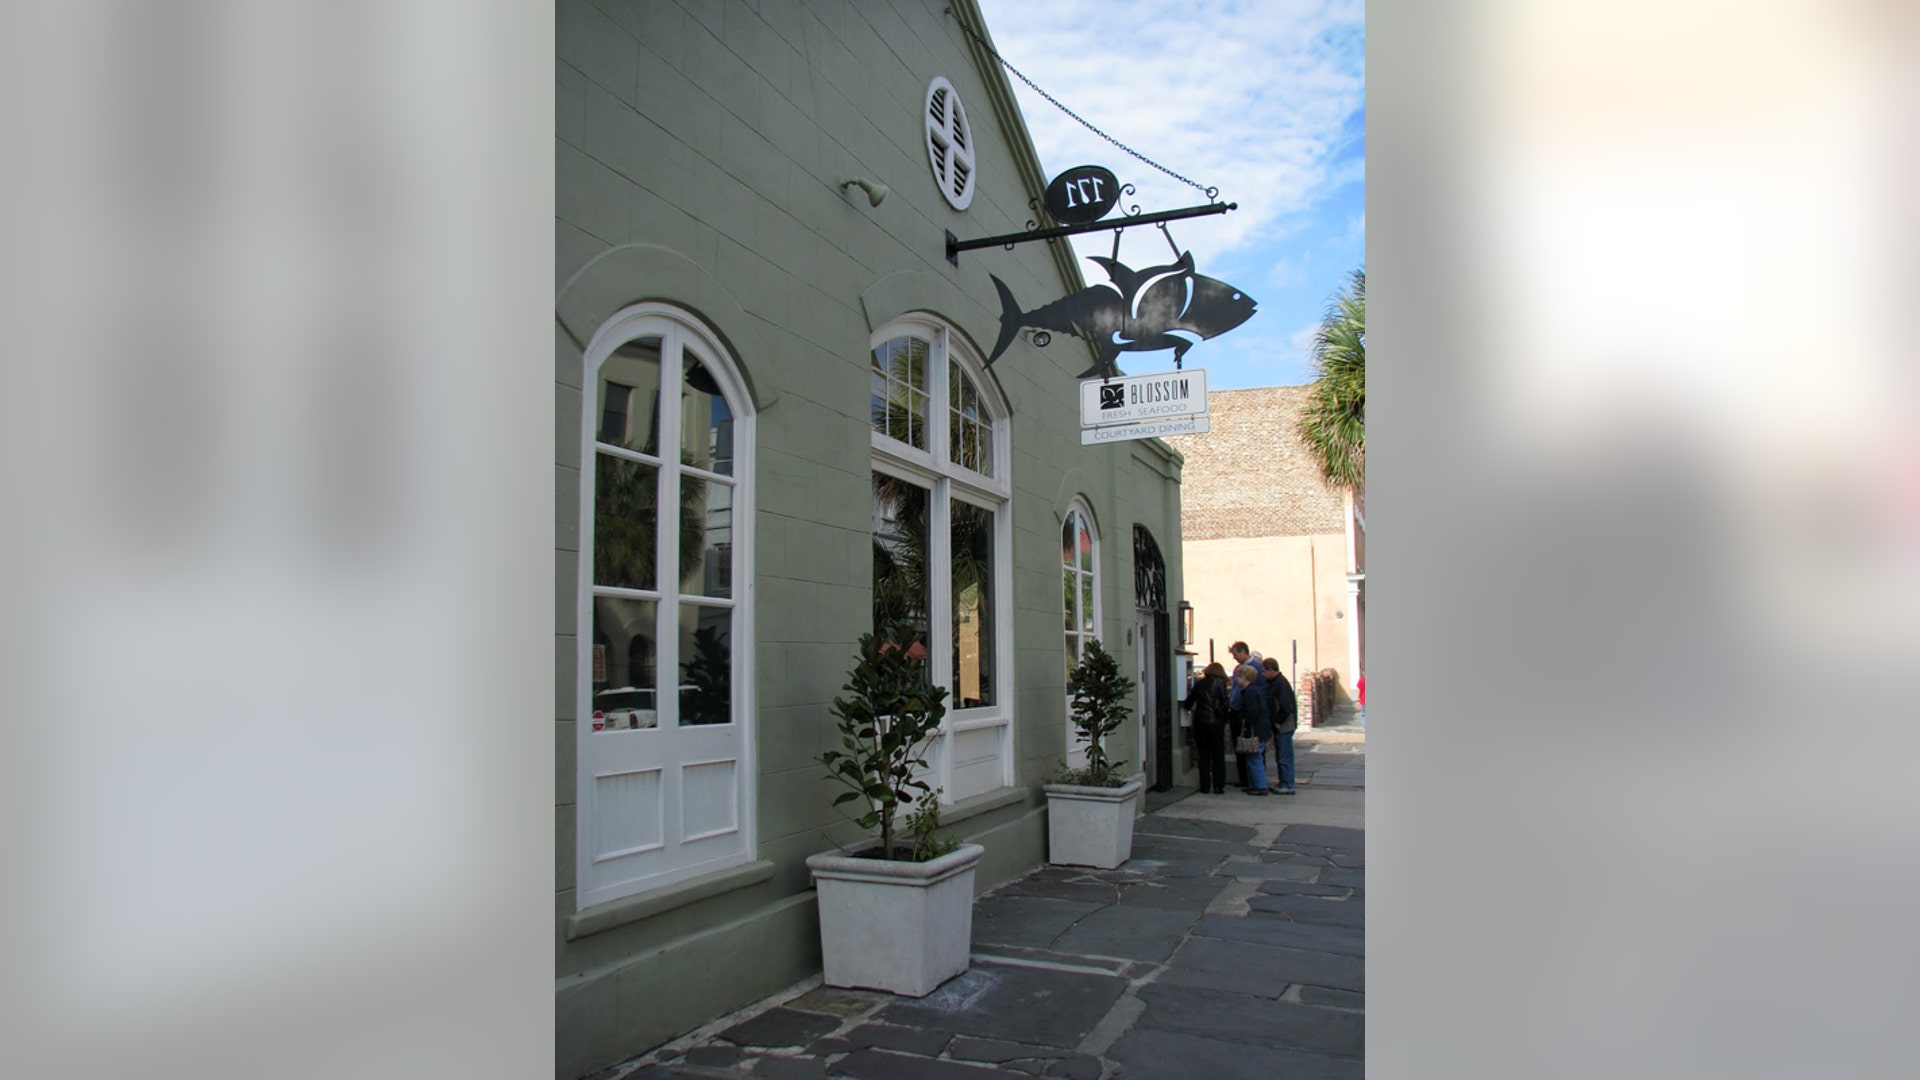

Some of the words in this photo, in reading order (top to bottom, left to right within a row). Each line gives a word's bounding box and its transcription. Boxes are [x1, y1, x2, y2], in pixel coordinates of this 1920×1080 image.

[1131, 379, 1189, 405] BLOSSOM
[1101, 410, 1131, 420] FRESH
[1137, 403, 1187, 416] SEAFOOD
[1094, 426, 1156, 440] COURTYARD
[1159, 422, 1196, 433] DINING
